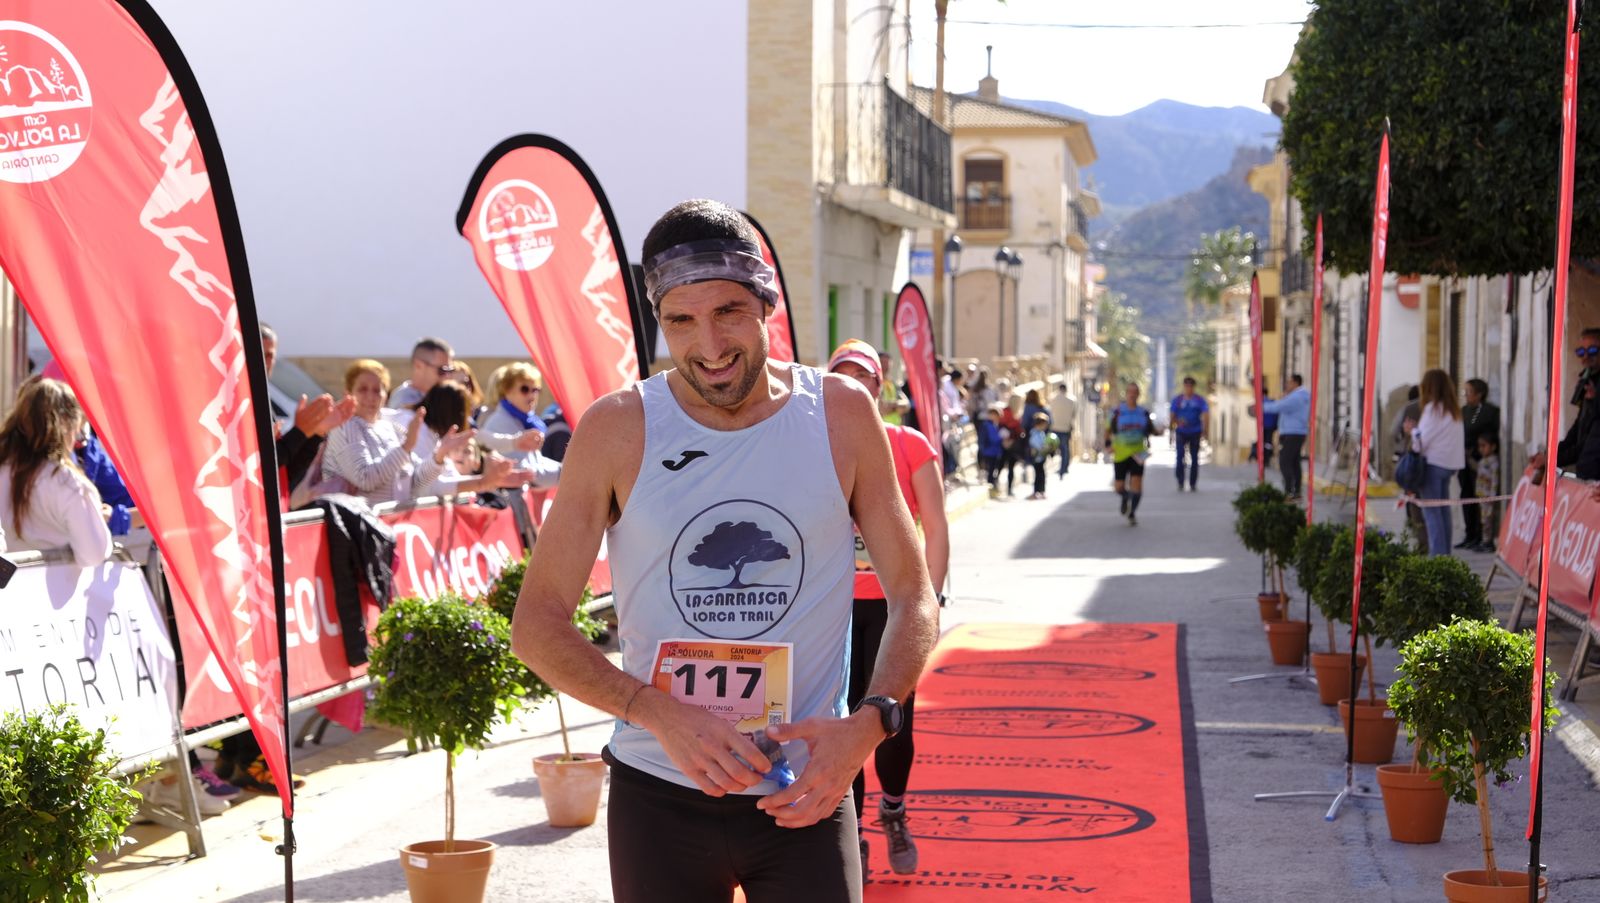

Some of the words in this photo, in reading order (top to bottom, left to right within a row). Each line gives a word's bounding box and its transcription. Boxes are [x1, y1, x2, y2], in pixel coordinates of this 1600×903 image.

[107, 609, 141, 637] DE
[693, 611, 735, 622] LORCA
[740, 611, 774, 622] TRAIL
[730, 647, 762, 656] CANTORIA
[5, 647, 157, 724] TORIA
[674, 663, 762, 699] 117
[1026, 873, 1075, 883] de
